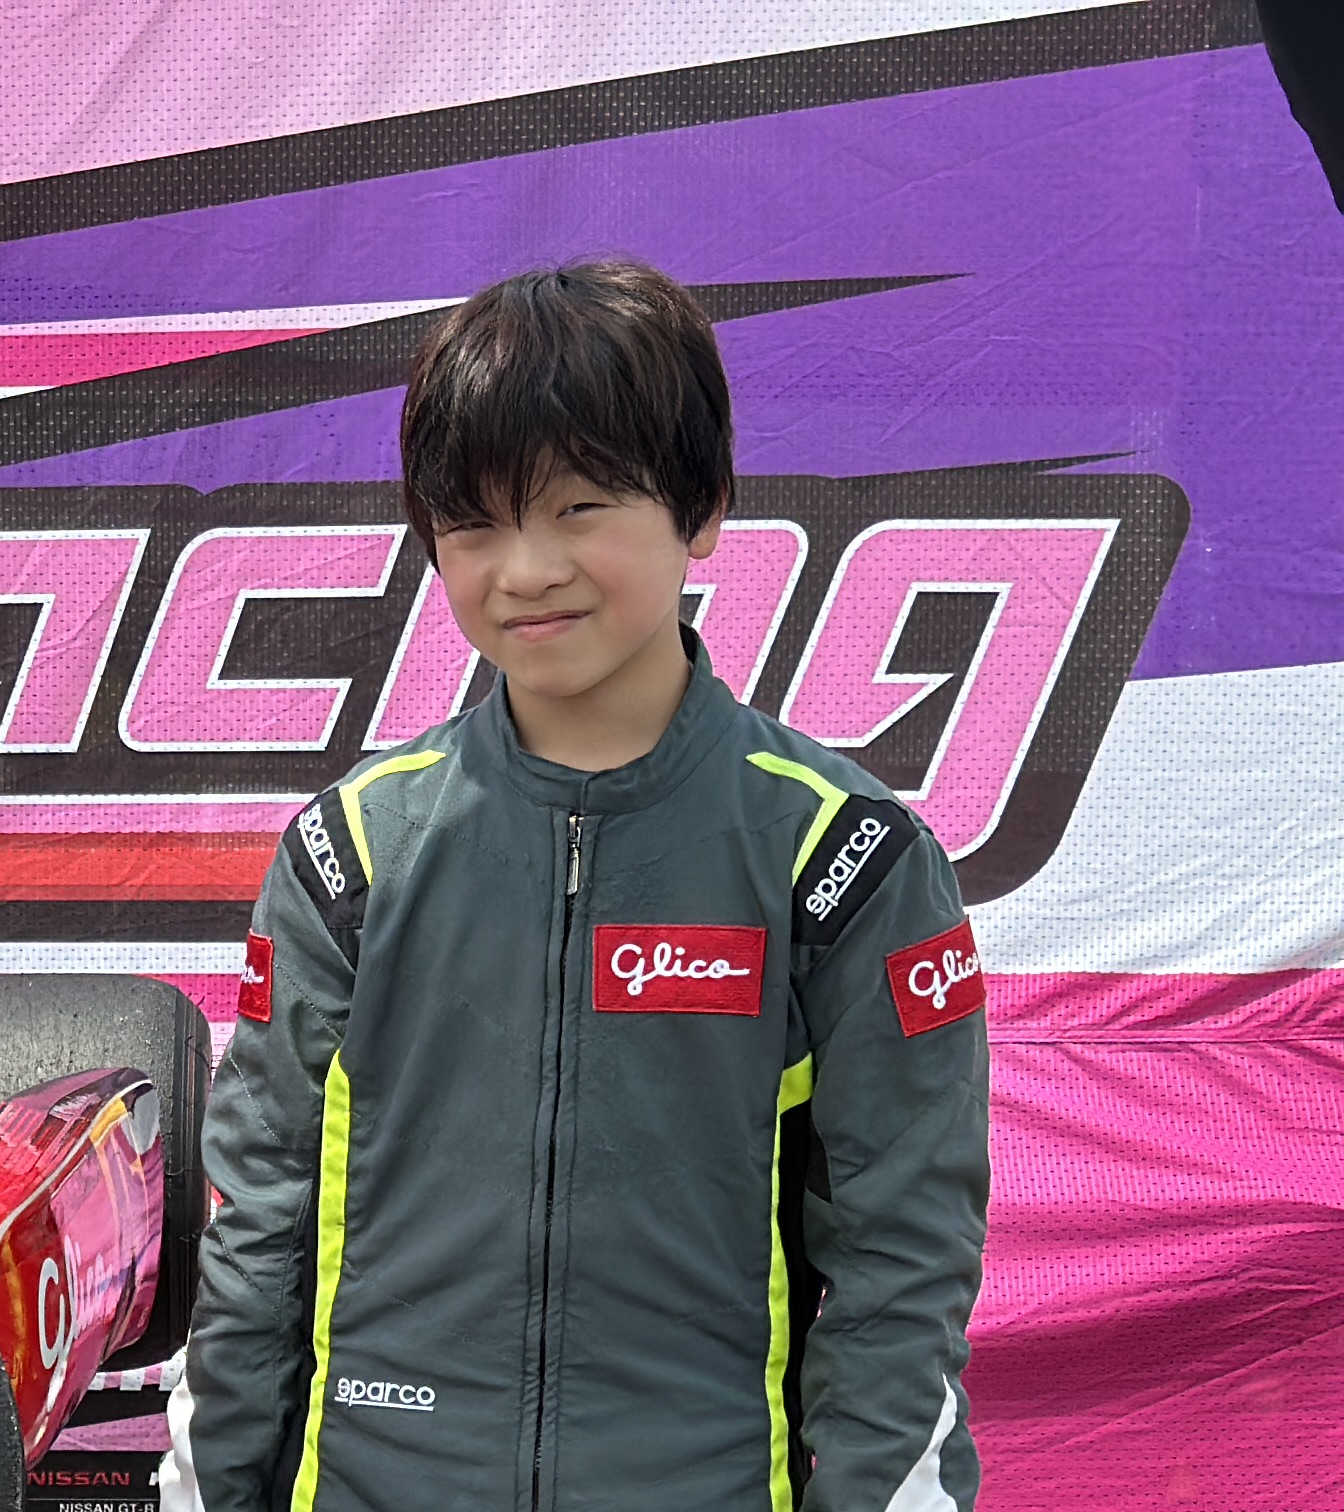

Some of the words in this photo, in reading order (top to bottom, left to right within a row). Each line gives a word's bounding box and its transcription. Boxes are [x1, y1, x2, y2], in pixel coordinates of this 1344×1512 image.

[300, 801, 348, 896] sparco
[805, 814, 890, 923] sparco
[610, 942, 751, 1000] Glico
[335, 1376, 436, 1412] sparco
[26, 1472, 130, 1486] NISSAN
